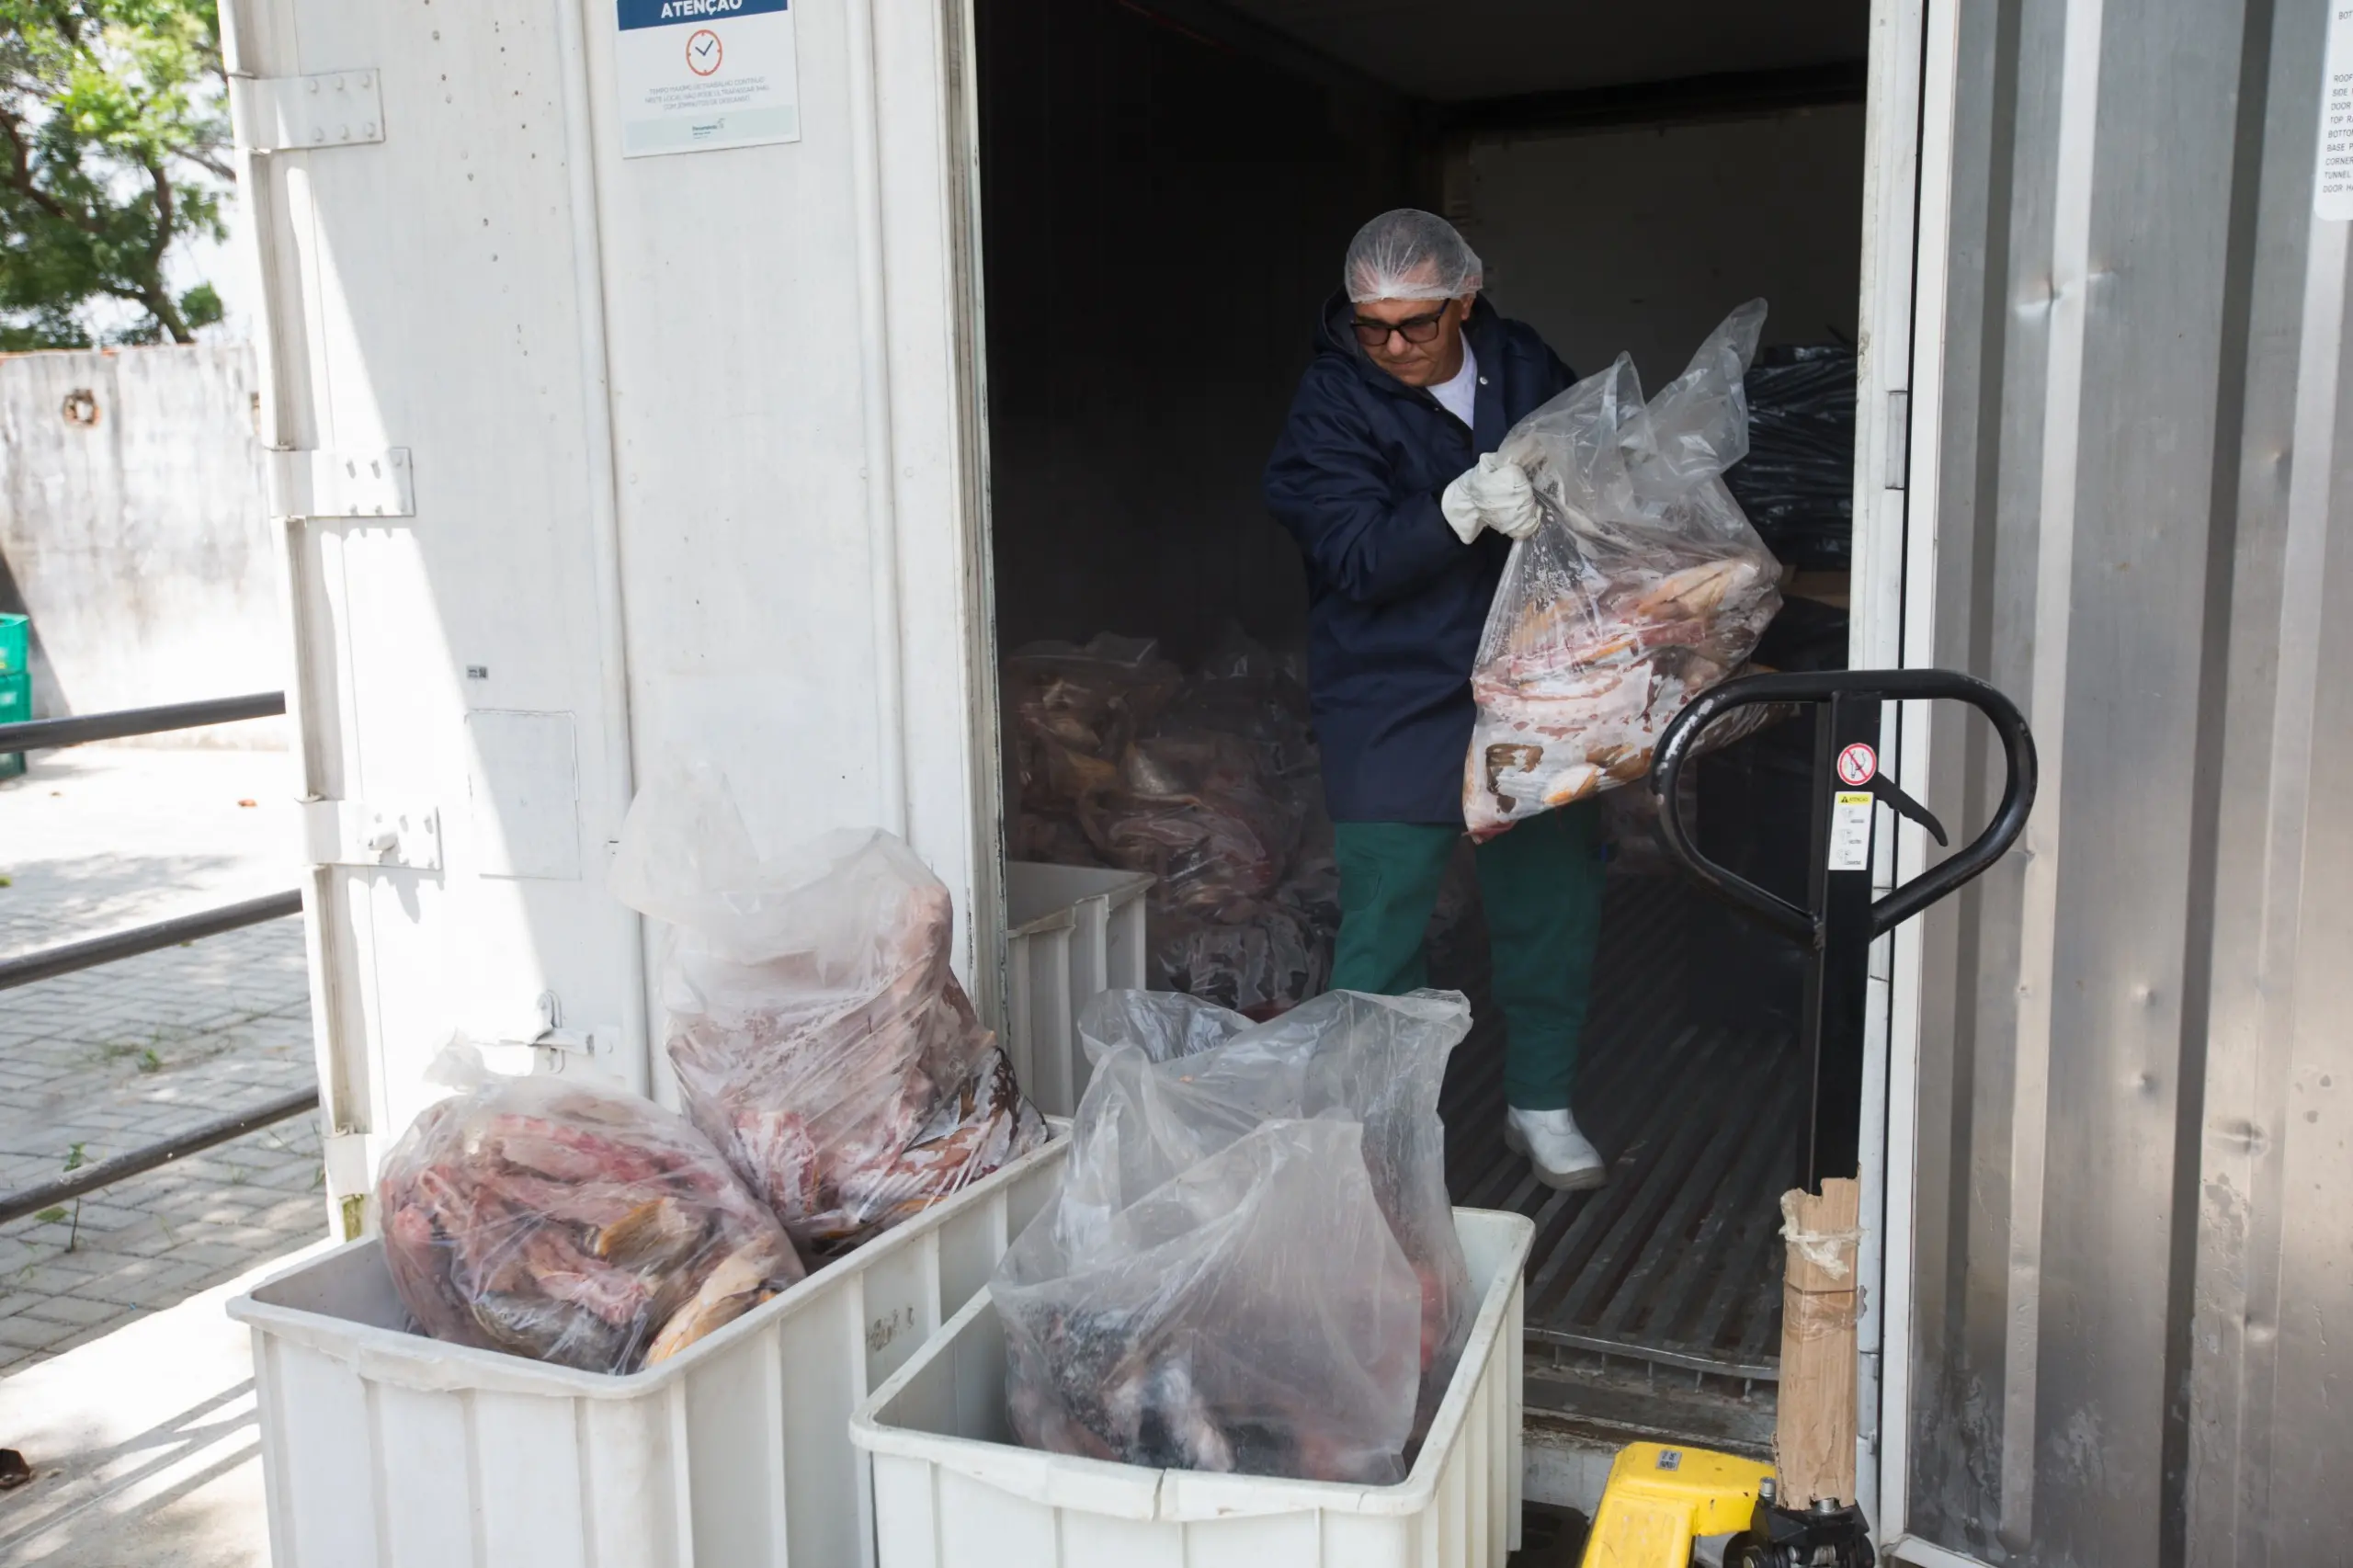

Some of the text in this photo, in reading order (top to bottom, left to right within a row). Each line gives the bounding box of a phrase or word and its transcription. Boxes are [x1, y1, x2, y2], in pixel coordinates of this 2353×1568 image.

[2332, 88, 2347, 97] SIDE
[2331, 102, 2351, 110] DOOR
[2330, 116, 2343, 124] TOP
[2326, 143, 2345, 152] BASE
[2325, 170, 2351, 179] TUNNEL
[2323, 185, 2343, 193] DOOR
